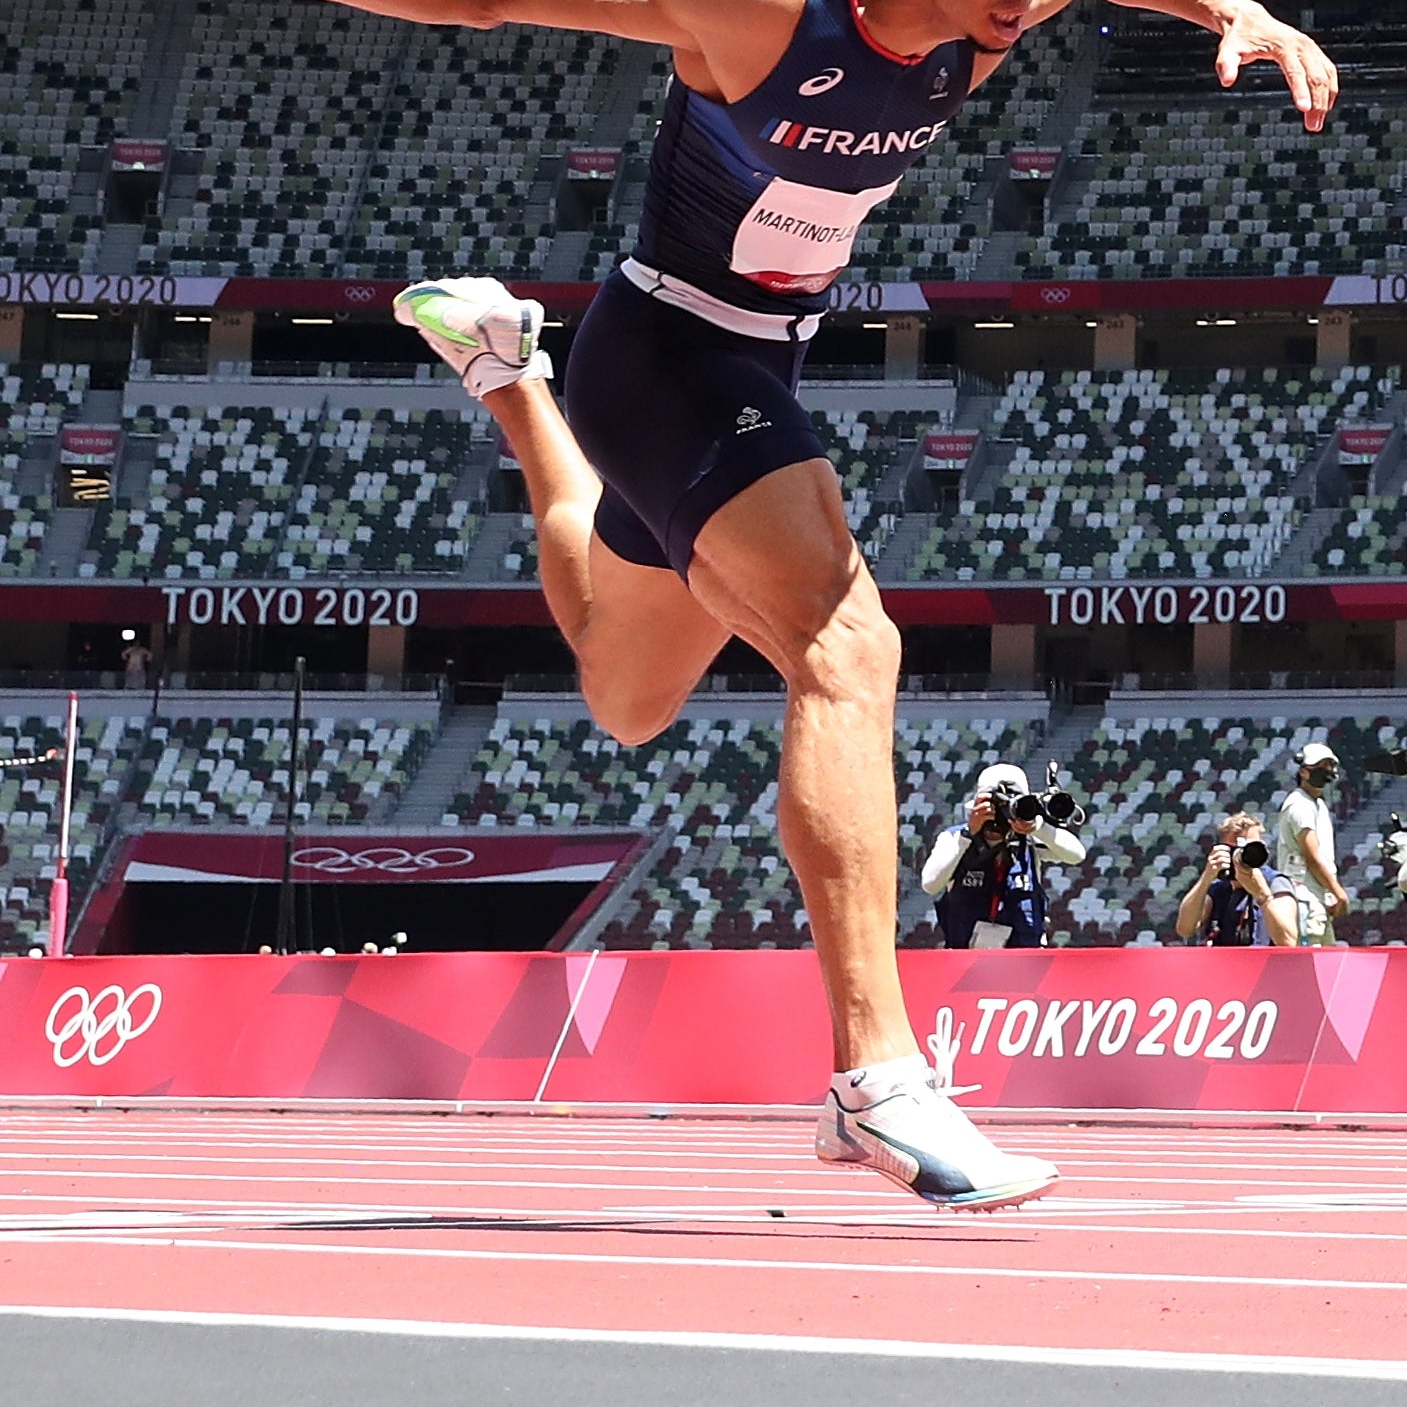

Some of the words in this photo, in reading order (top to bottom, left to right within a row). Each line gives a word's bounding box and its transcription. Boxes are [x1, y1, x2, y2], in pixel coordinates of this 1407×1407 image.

[798, 119, 948, 156] FRANCE
[94, 275, 177, 304] 2020
[827, 282, 882, 311] 020
[163, 587, 304, 625] TOKYO
[314, 587, 419, 625] 2020
[1044, 587, 1178, 625] TOKYO
[1189, 585, 1286, 624] 2020
[971, 997, 1137, 1057] TOKYO
[1135, 997, 1278, 1058] 2020
